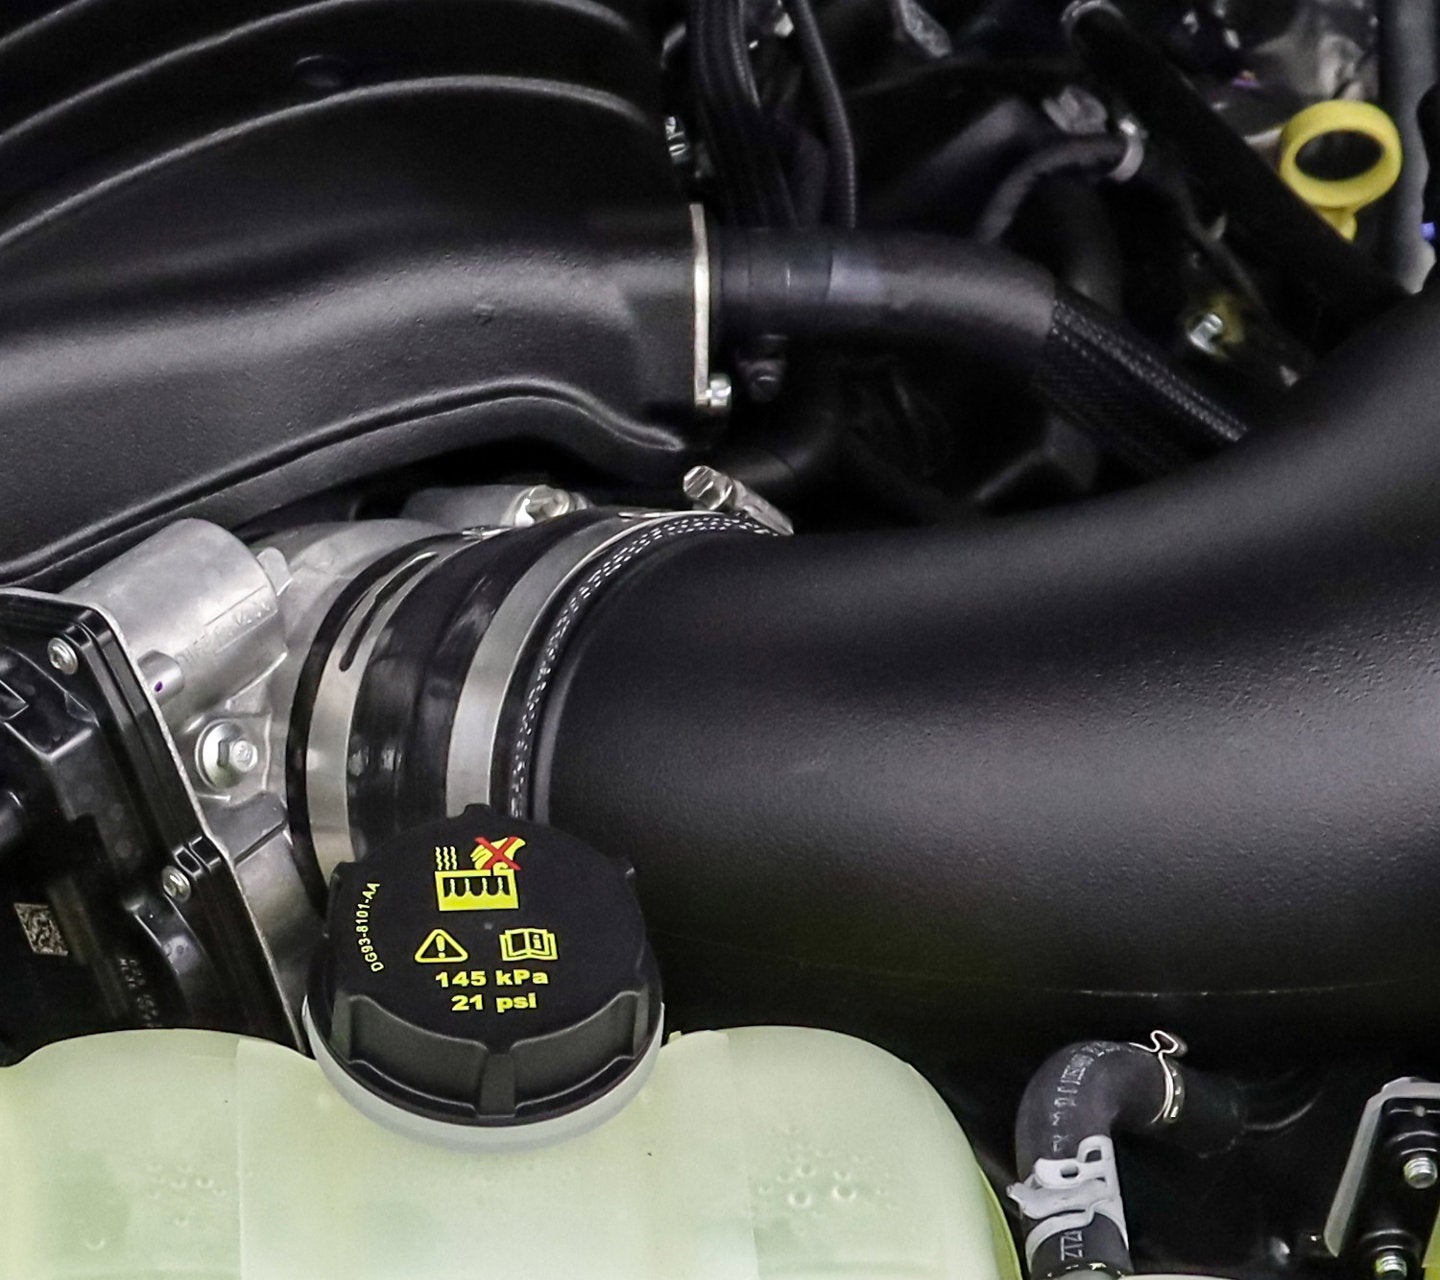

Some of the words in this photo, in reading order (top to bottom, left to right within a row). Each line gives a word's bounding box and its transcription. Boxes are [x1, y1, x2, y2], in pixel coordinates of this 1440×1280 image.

[355, 882, 385, 972] DG93-8101-AA
[435, 970, 487, 988] 145
[495, 968, 549, 986] kPa
[451, 994, 484, 1011] 21
[496, 992, 537, 1013] psi
